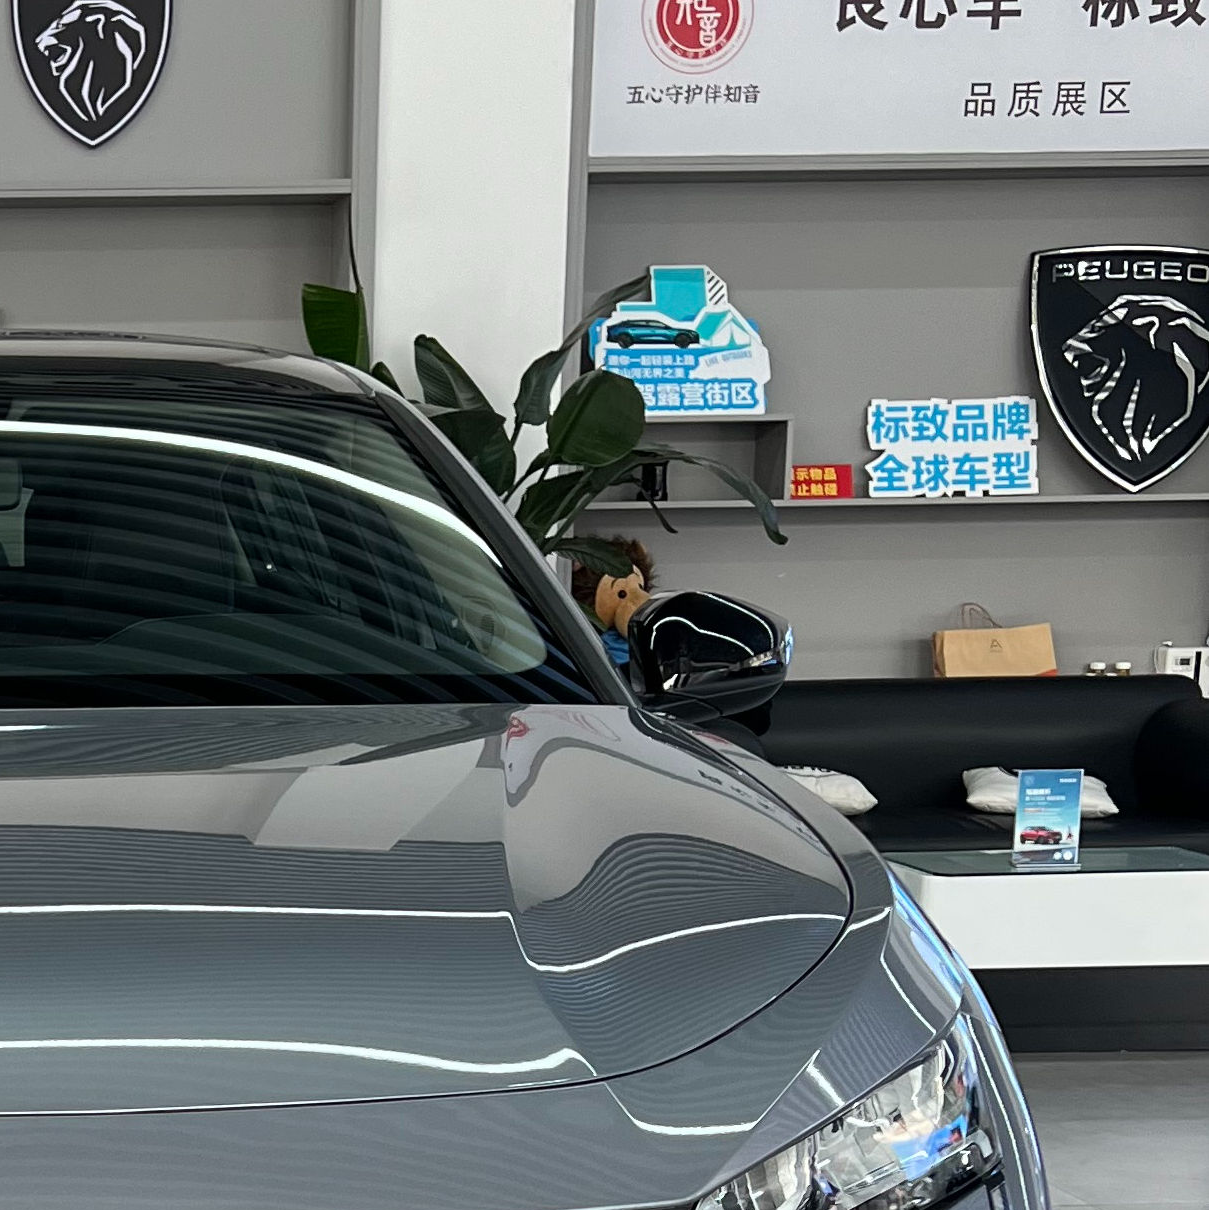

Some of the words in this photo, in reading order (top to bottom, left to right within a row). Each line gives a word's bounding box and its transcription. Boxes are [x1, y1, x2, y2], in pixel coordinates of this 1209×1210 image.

[626, 83, 760, 105] 五心守护伴知音
[963, 81, 1131, 117] 品质展区
[872, 401, 1031, 443] 标致品牌
[791, 467, 838, 481] 示物品
[873, 451, 1031, 493] 全球车型
[791, 483, 838, 497] 止触碰
